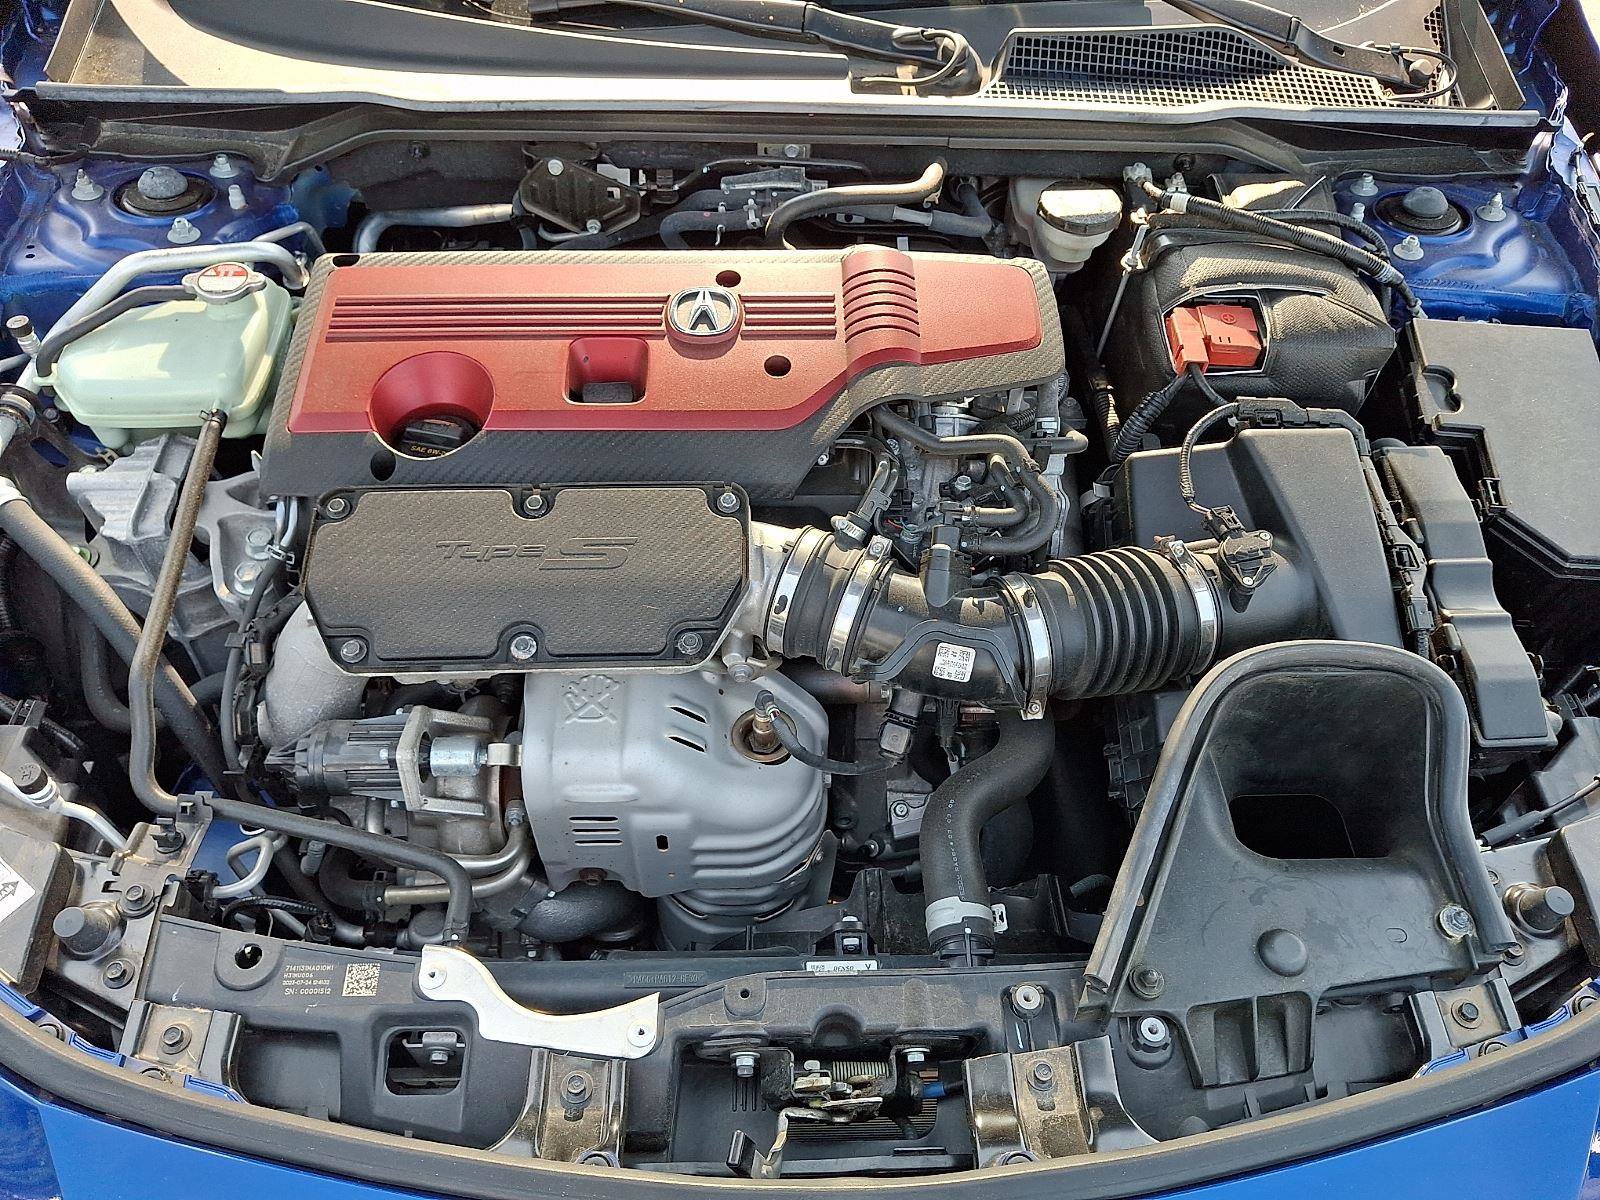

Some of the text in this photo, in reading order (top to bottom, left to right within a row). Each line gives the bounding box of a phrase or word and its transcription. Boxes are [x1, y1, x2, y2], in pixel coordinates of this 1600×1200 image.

[410, 445, 446, 456] SAE 0W-2
[538, 537, 639, 570] S
[284, 987, 298, 996] SN:
